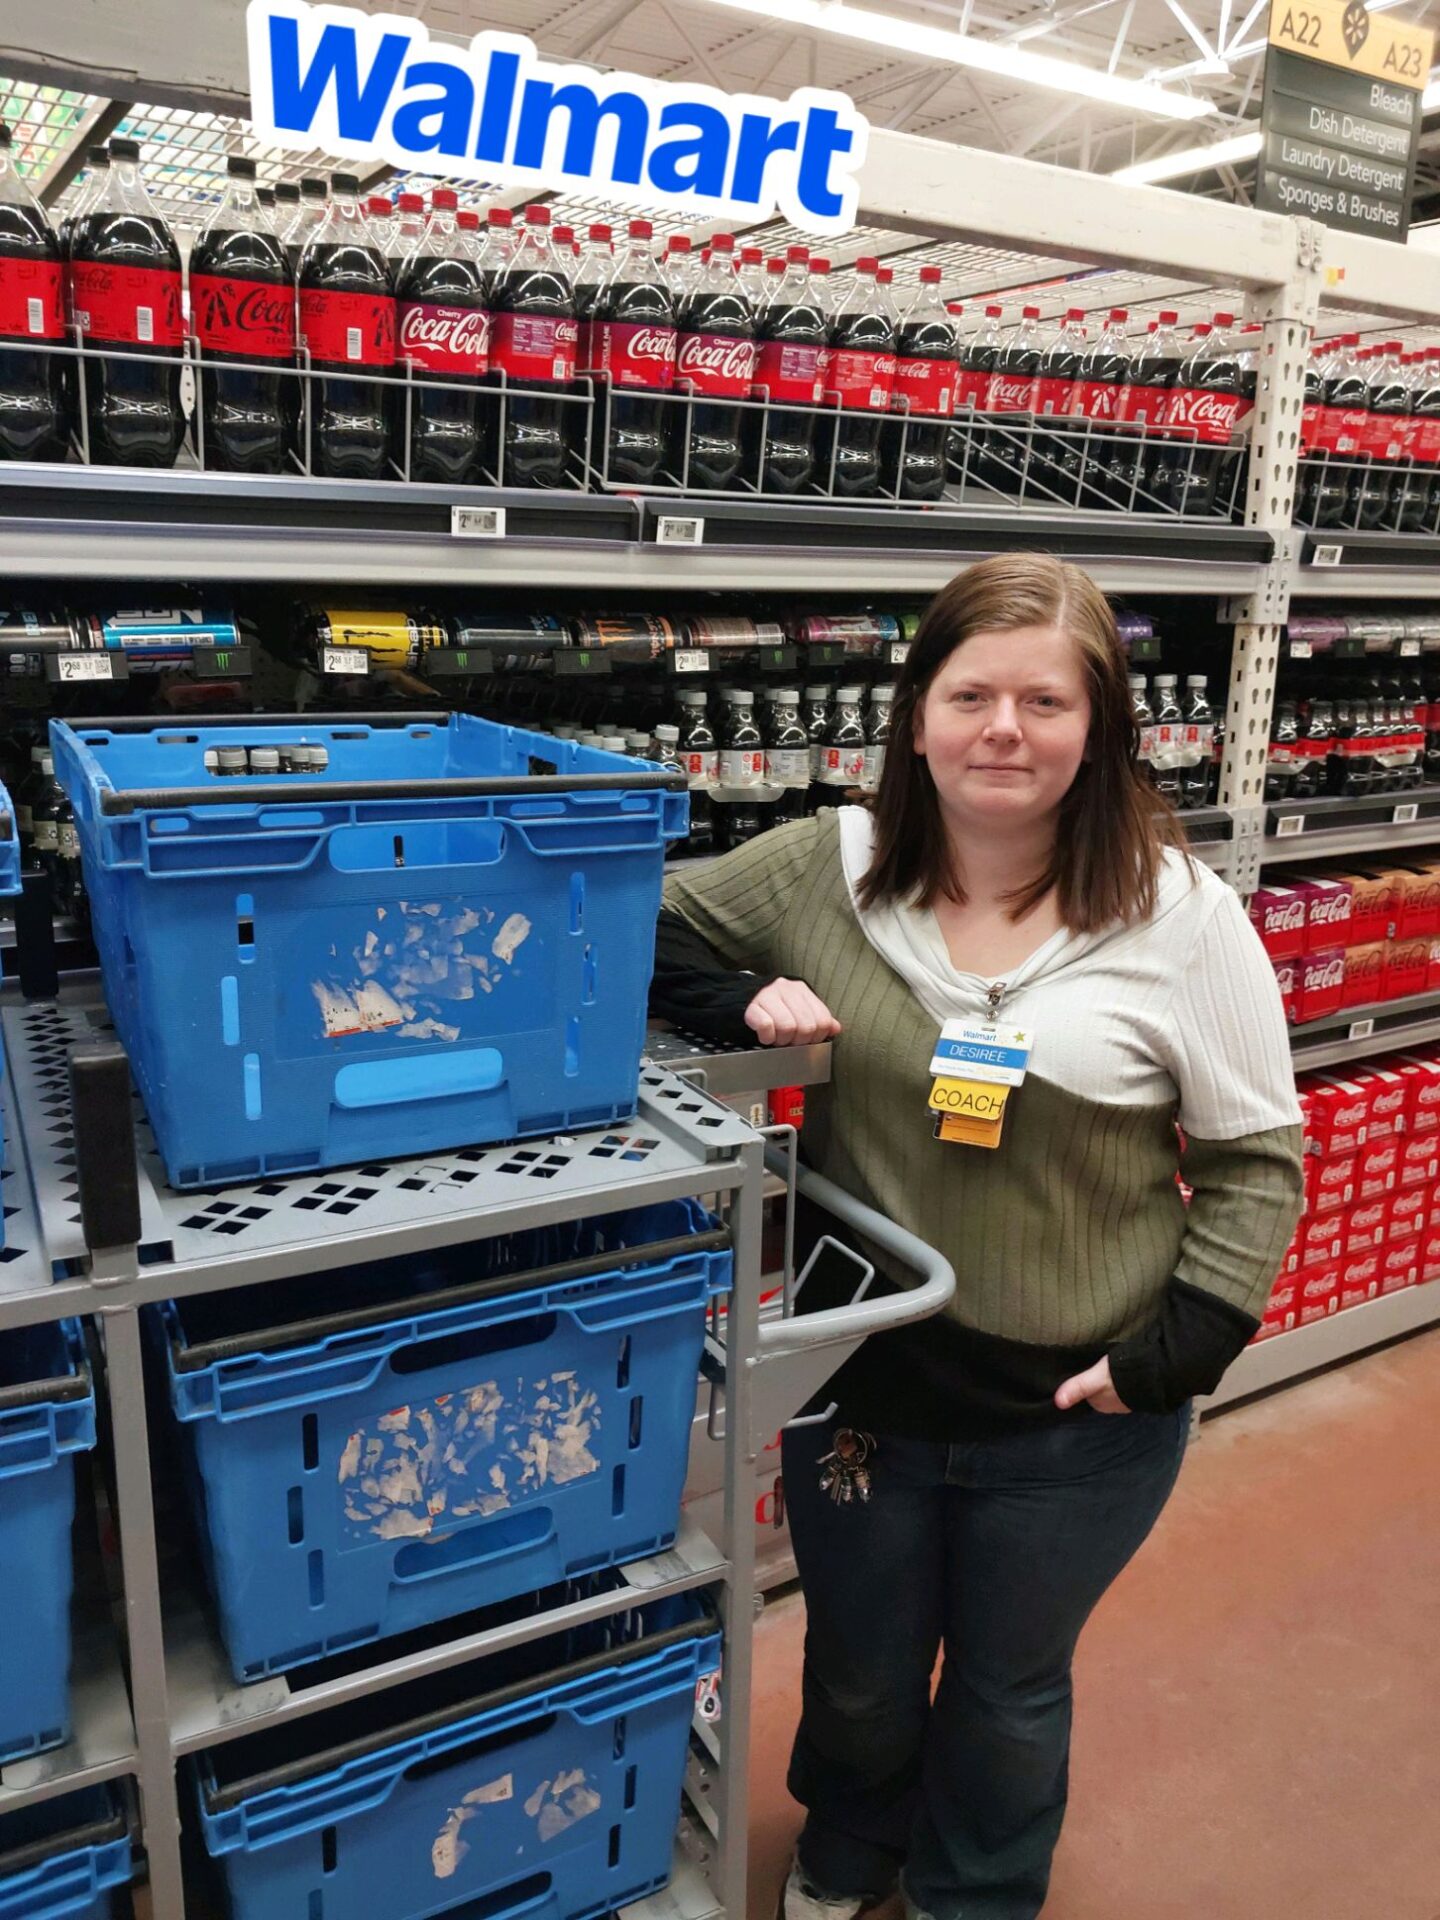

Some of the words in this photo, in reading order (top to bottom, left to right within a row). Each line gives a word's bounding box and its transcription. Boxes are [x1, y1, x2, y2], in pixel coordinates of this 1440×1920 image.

[1279, 8, 1322, 48] A22
[1382, 41, 1423, 78] A23
[1370, 84, 1413, 115] Bleach
[1309, 107, 1338, 135] Dish
[1341, 117, 1408, 154] Detergent
[1281, 140, 1335, 179] Laundry
[1338, 154, 1403, 191] Detergent
[1278, 177, 1334, 213] Sponges
[1337, 192, 1347, 214] &
[1350, 196, 1400, 227] Brushes
[950, 1043, 1008, 1063] DESIREE
[963, 1029, 997, 1043] Walmart
[932, 1087, 1005, 1115] COACH
